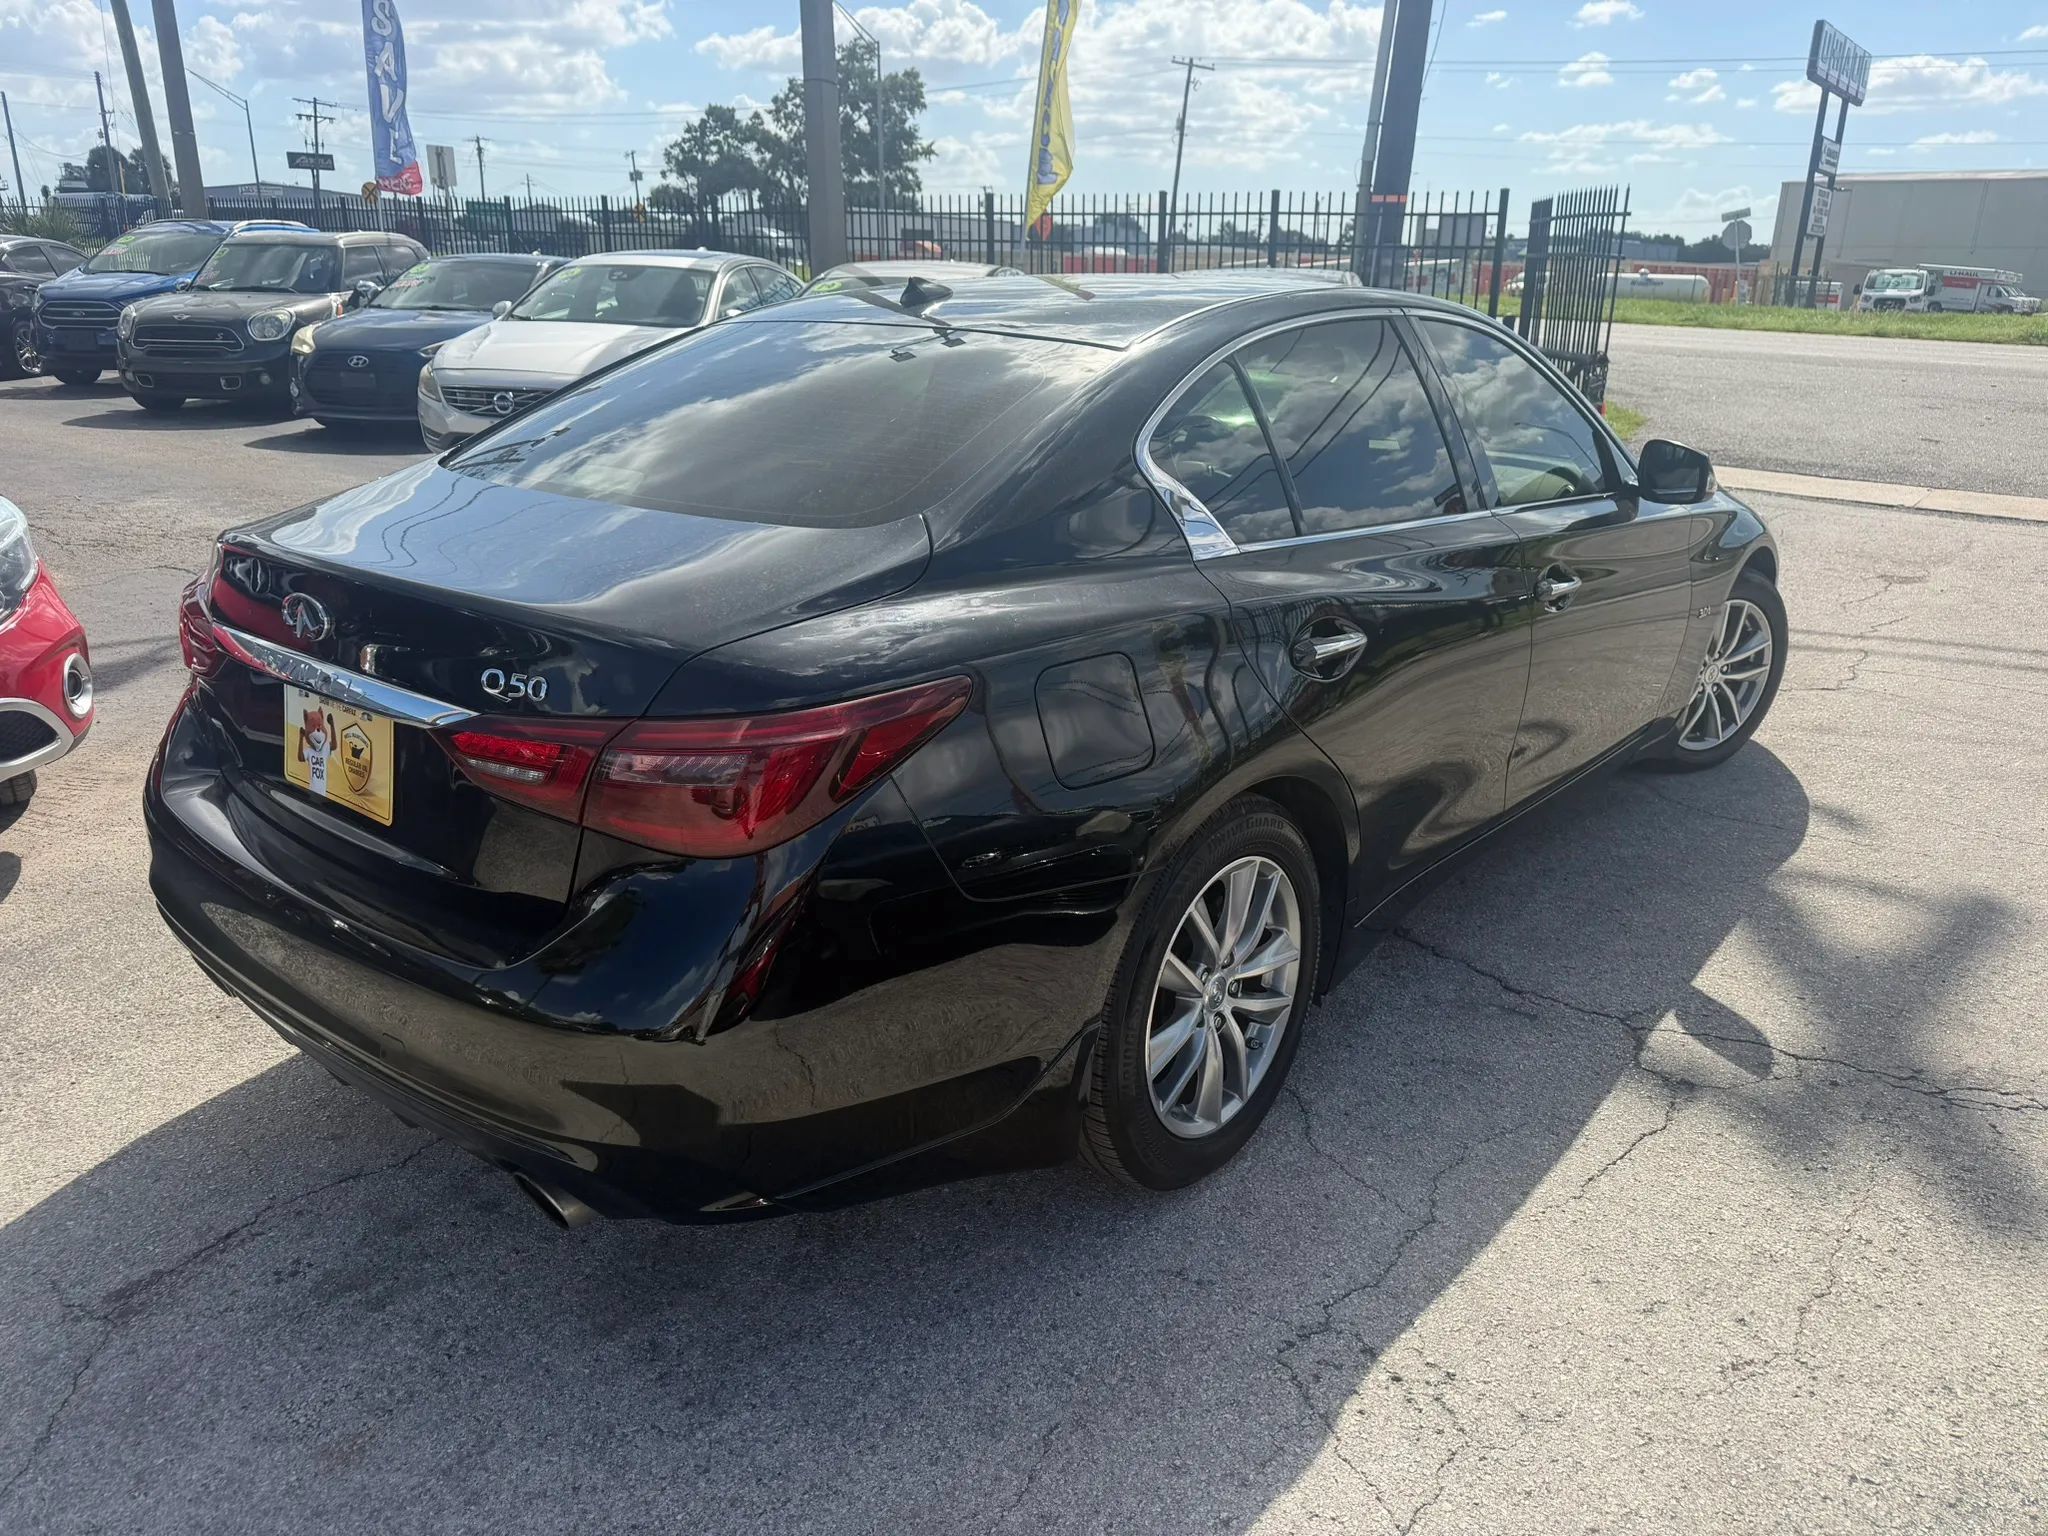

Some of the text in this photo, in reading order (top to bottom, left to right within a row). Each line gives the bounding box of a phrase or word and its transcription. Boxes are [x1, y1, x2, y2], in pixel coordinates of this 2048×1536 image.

[481, 668, 547, 702] Q50
[311, 755, 325, 768] CAR
[311, 766, 325, 780] FOX
